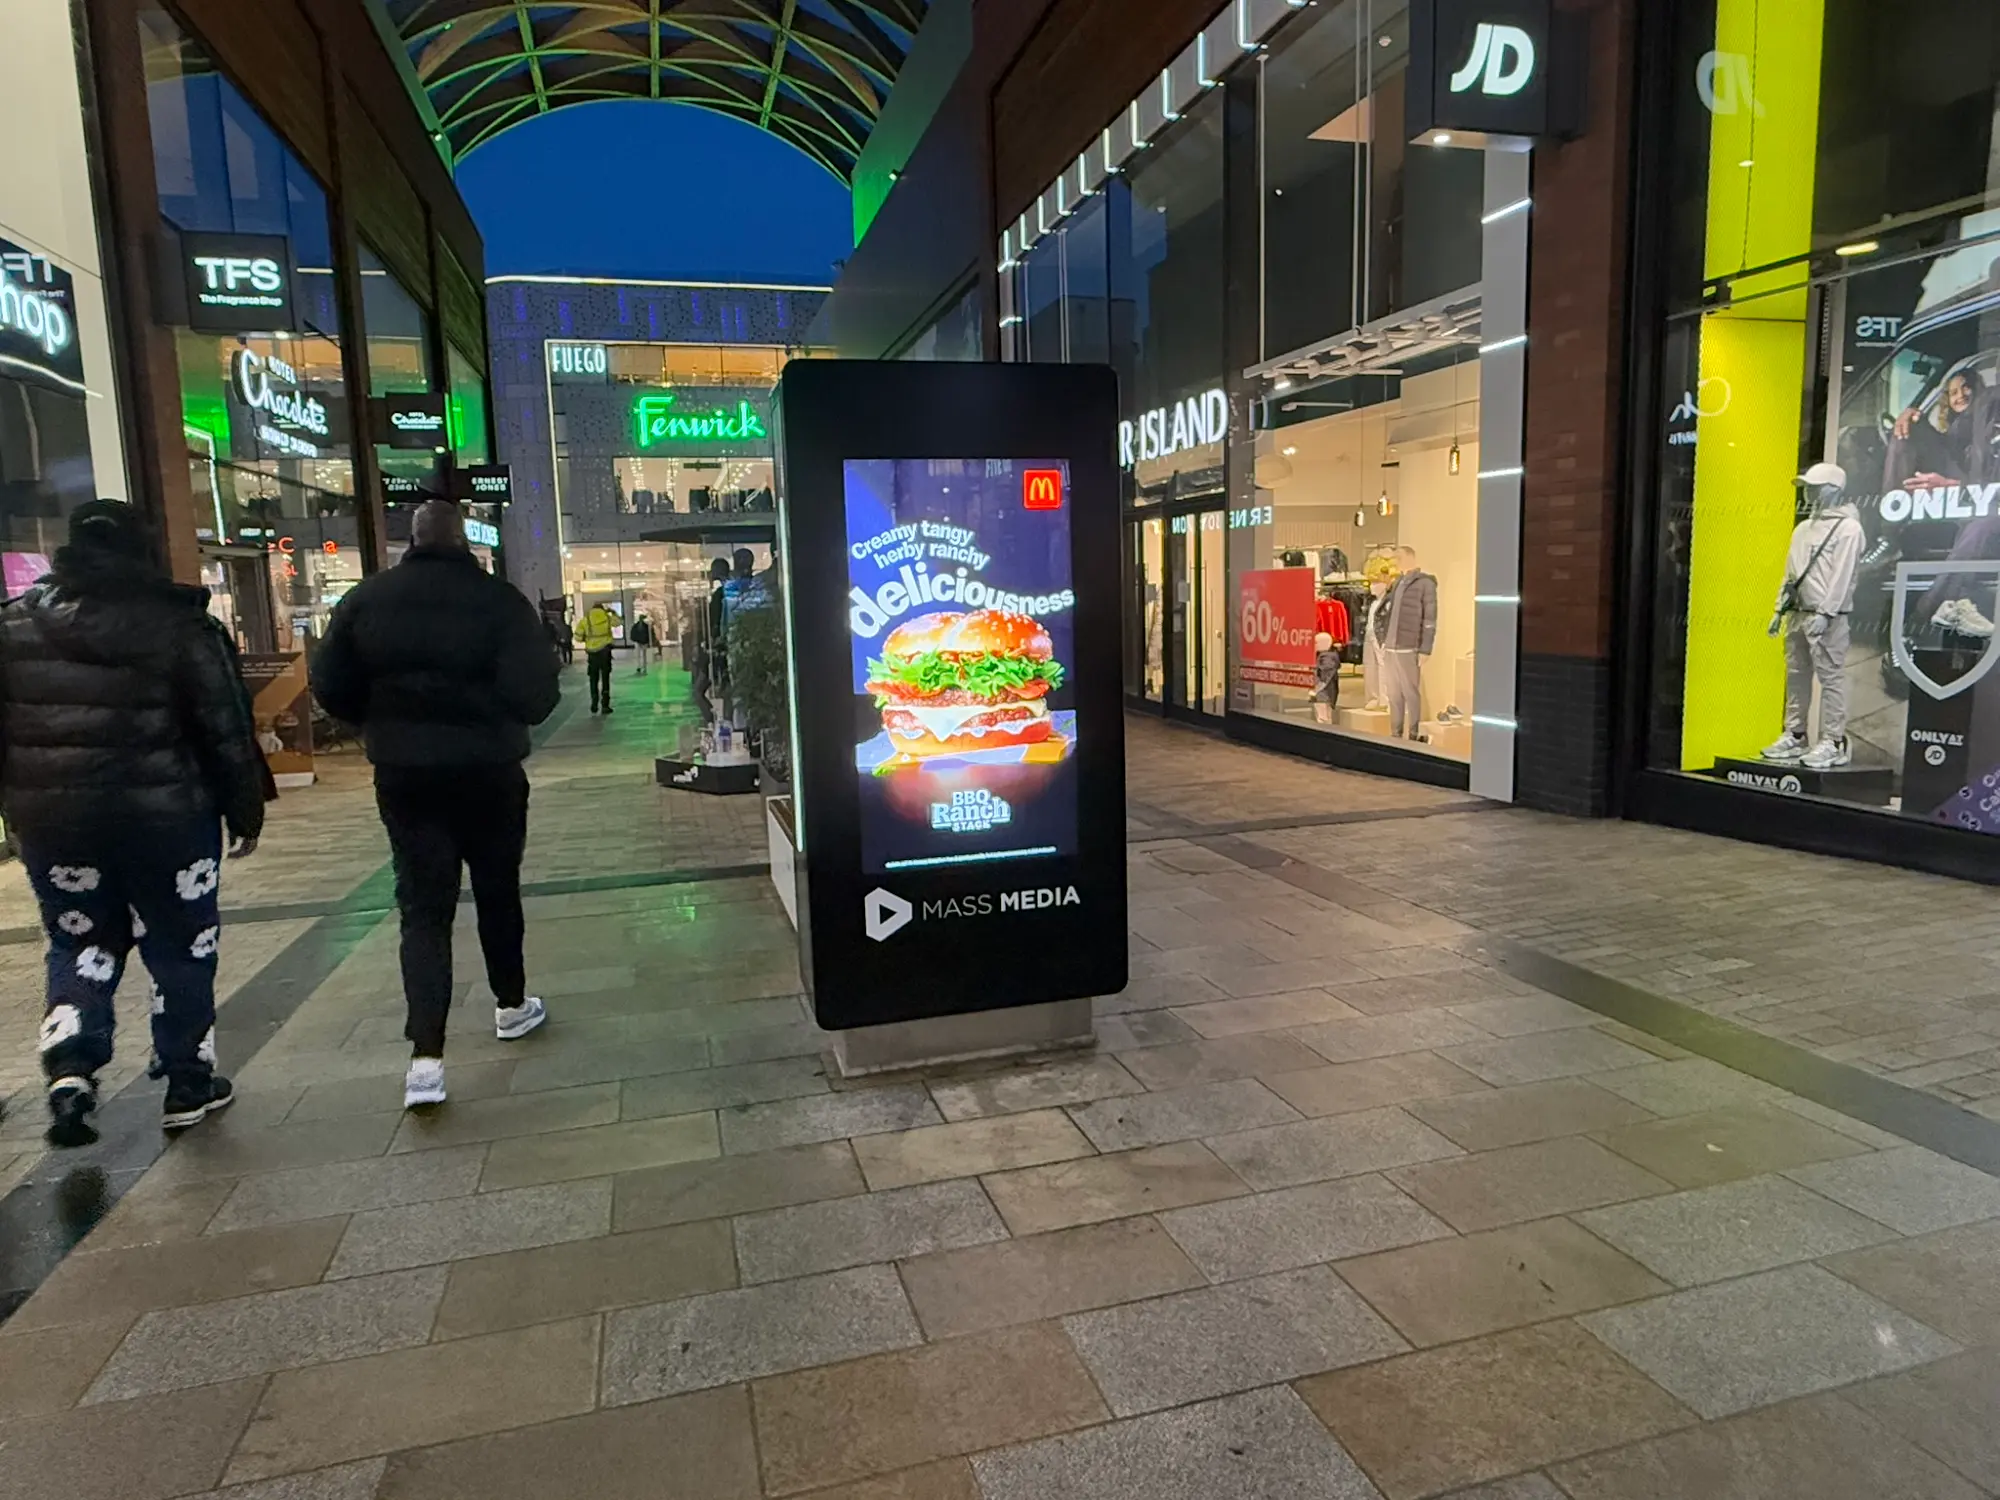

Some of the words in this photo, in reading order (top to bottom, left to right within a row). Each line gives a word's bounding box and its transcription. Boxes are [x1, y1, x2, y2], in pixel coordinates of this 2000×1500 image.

[1450, 23, 1535, 95] JD
[194, 257, 281, 292] TFS
[551, 346, 606, 373] FUEGO
[633, 395, 766, 447] Fenwick
[1139, 388, 1229, 461] ISLAND
[852, 522, 918, 560] Creamy
[921, 520, 975, 546] tangy
[873, 542, 925, 570] herby
[929, 542, 990, 571] ranchy
[849, 561, 1075, 638] deliciousness
[1242, 600, 1289, 645] 60%
[1290, 629, 1313, 646] OFF
[1270, 670, 1315, 687] REDUCTIONS
[931, 796, 1010, 824] Ranch
[952, 789, 991, 806] BBQ
[922, 894, 992, 920] MASS
[1000, 886, 1081, 912] MEDIA
